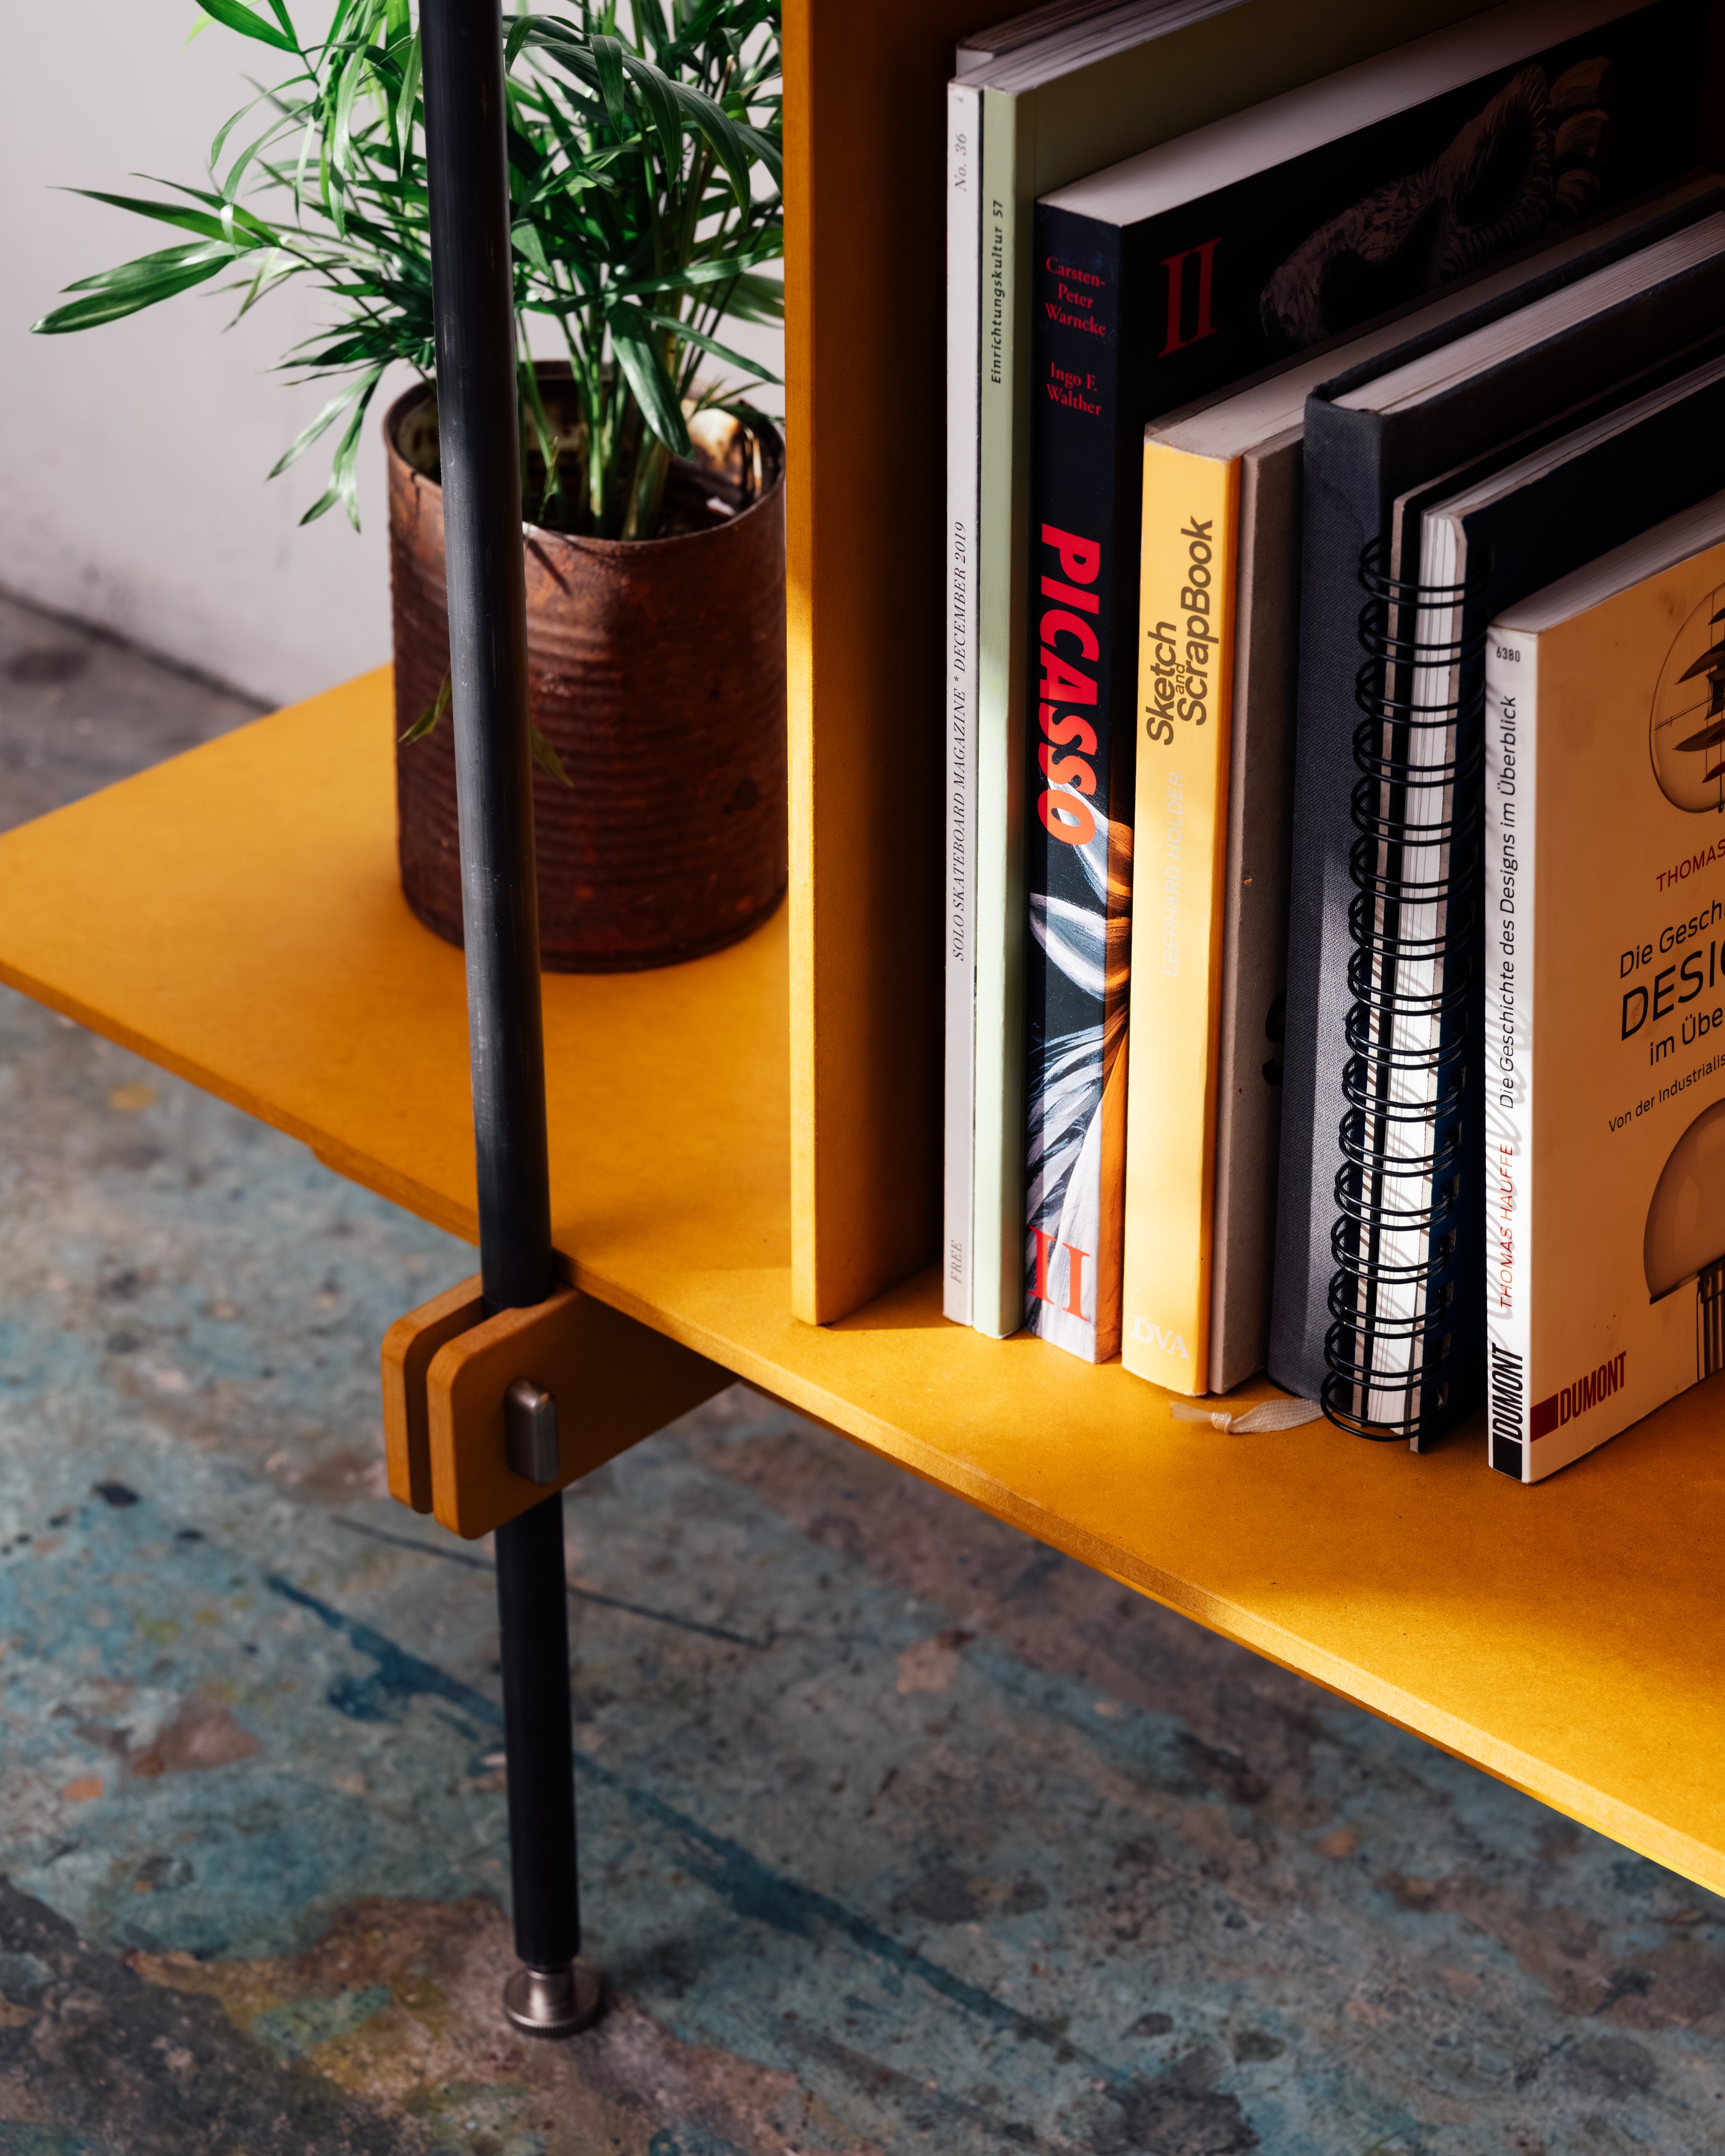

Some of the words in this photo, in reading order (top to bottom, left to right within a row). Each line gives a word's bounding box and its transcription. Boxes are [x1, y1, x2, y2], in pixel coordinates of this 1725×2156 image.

[955, 133, 967, 156] 36
[954, 164, 967, 192] No.
[992, 200, 1004, 219] 57
[1045, 257, 1105, 288] Carsten-
[1058, 283, 1094, 309] Peter
[1159, 237, 1222, 357] II
[991, 225, 1005, 384] Einrichtungskultur
[1045, 301, 1106, 338] Warncke
[1046, 383, 1102, 416] Walther
[1050, 362, 1082, 389] Ingo
[1086, 375, 1097, 392] F.
[954, 522, 966, 565] 2019
[954, 567, 966, 673] DECEMBER
[1177, 516, 1219, 726] ScrapBook
[1174, 663, 1186, 695] and
[1496, 646, 1520, 663] 6380
[1037, 523, 1100, 845] PICASSO
[1146, 621, 1177, 745] Sketch
[952, 688, 966, 789] MAGAZINE
[1497, 695, 1516, 796] Überblick
[1167, 772, 1183, 860] HOLDER
[1500, 803, 1515, 828] im
[953, 793, 966, 911] SKATEBOARD
[1500, 834, 1518, 914] Designs
[1656, 839, 1725, 892] THOMAS
[953, 915, 965, 962] SOLO
[1164, 865, 1181, 978] EBERHARD
[1500, 920, 1514, 955] des
[1620, 944, 1652, 979] Die
[1500, 960, 1514, 1071] Geschichte
[1622, 941, 1725, 1040] DESI
[1650, 1036, 1674, 1066] im
[1500, 1077, 1513, 1109] Die
[1609, 1110, 1631, 1133] Von
[1636, 1096, 1655, 1117] der
[1500, 1144, 1513, 1220] HAUFFE
[951, 1239, 962, 1284] FREE
[1028, 1225, 1090, 1322] II
[1500, 1226, 1512, 1308] THOMAS
[1130, 1315, 1190, 1359] DVA
[1492, 1342, 1523, 1441] DUMONT
[1561, 1351, 1626, 1427] DUMONT
